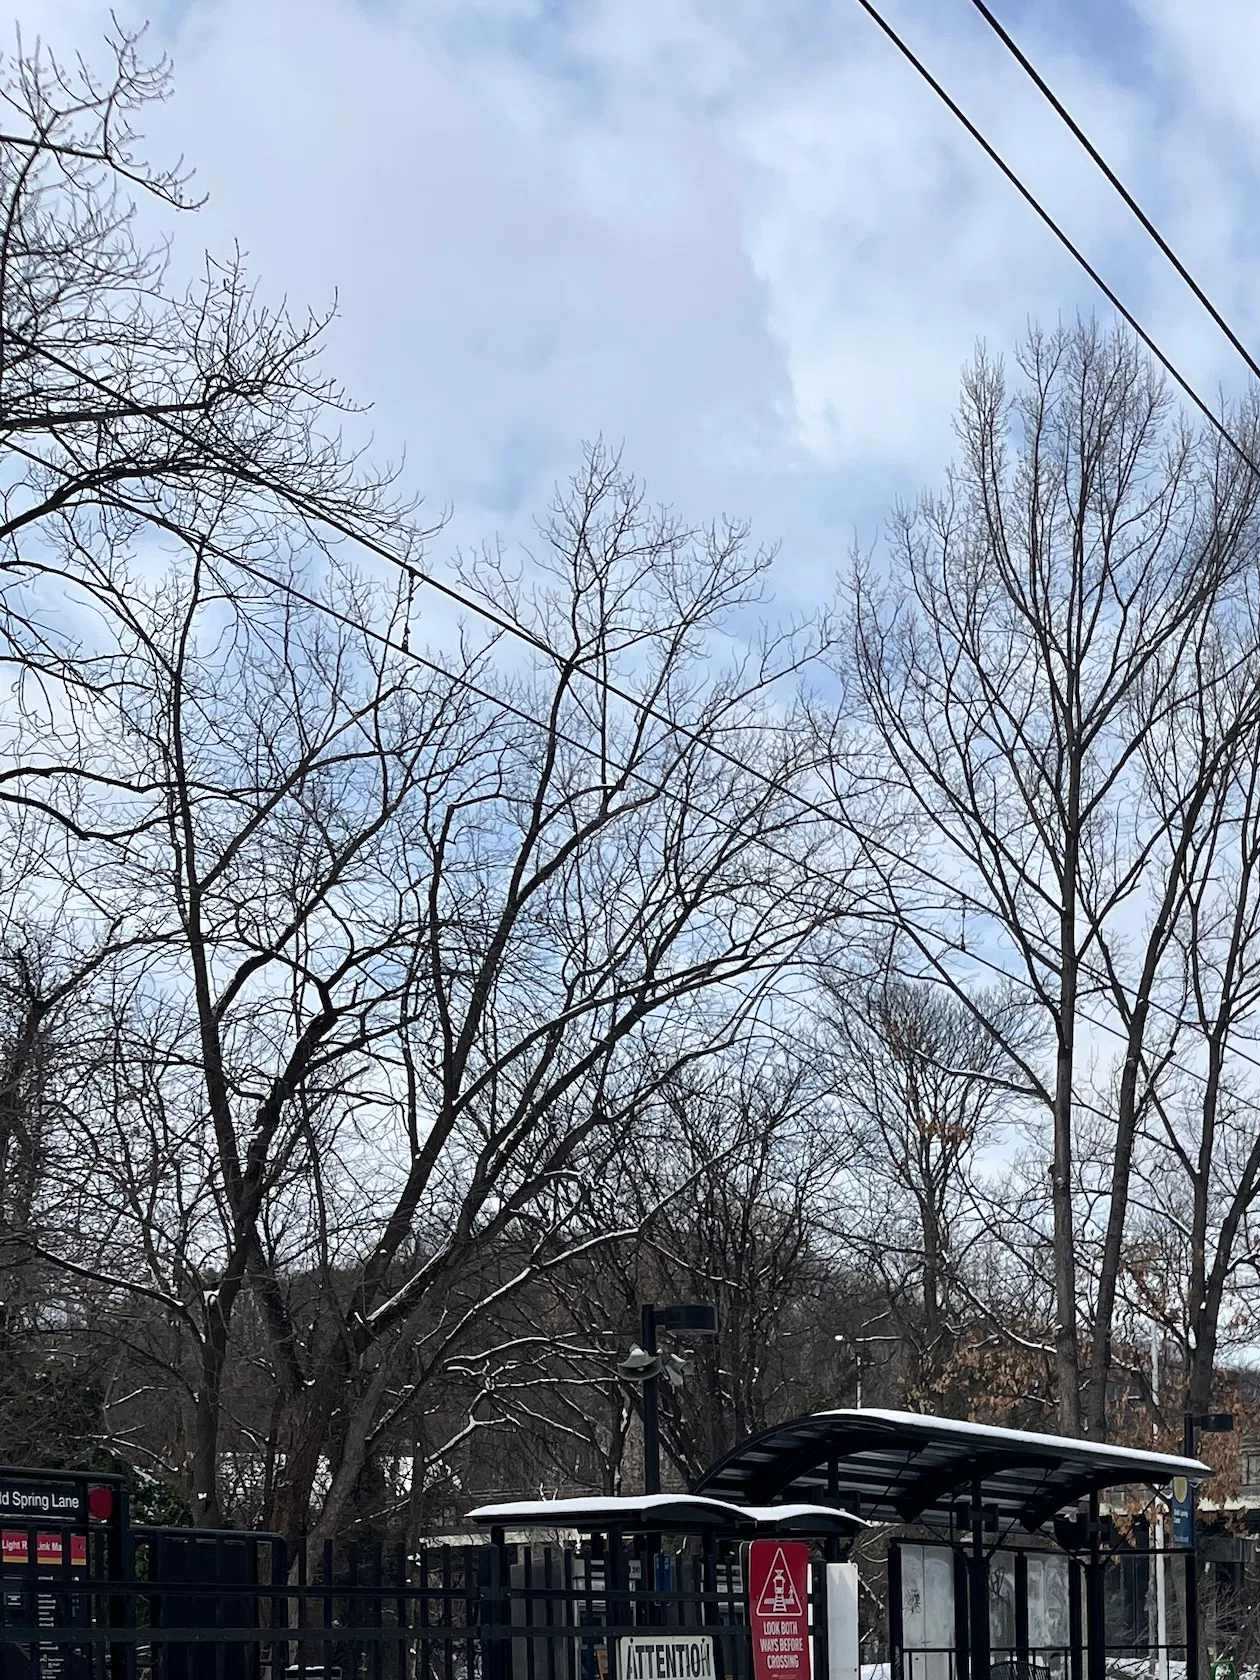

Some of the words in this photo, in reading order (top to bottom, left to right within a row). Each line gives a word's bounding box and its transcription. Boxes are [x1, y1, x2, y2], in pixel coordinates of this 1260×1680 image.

[12, 1491, 49, 1510] Spring
[51, 1493, 80, 1509] Lane
[2, 1540, 20, 1552] Light
[763, 1621, 780, 1635] LOOK
[780, 1621, 798, 1635] BOTH
[760, 1638, 779, 1652] WAYS
[780, 1638, 803, 1652] BEFORE
[626, 1642, 711, 1680] ATTENTION
[767, 1654, 799, 1669] CROSSING
